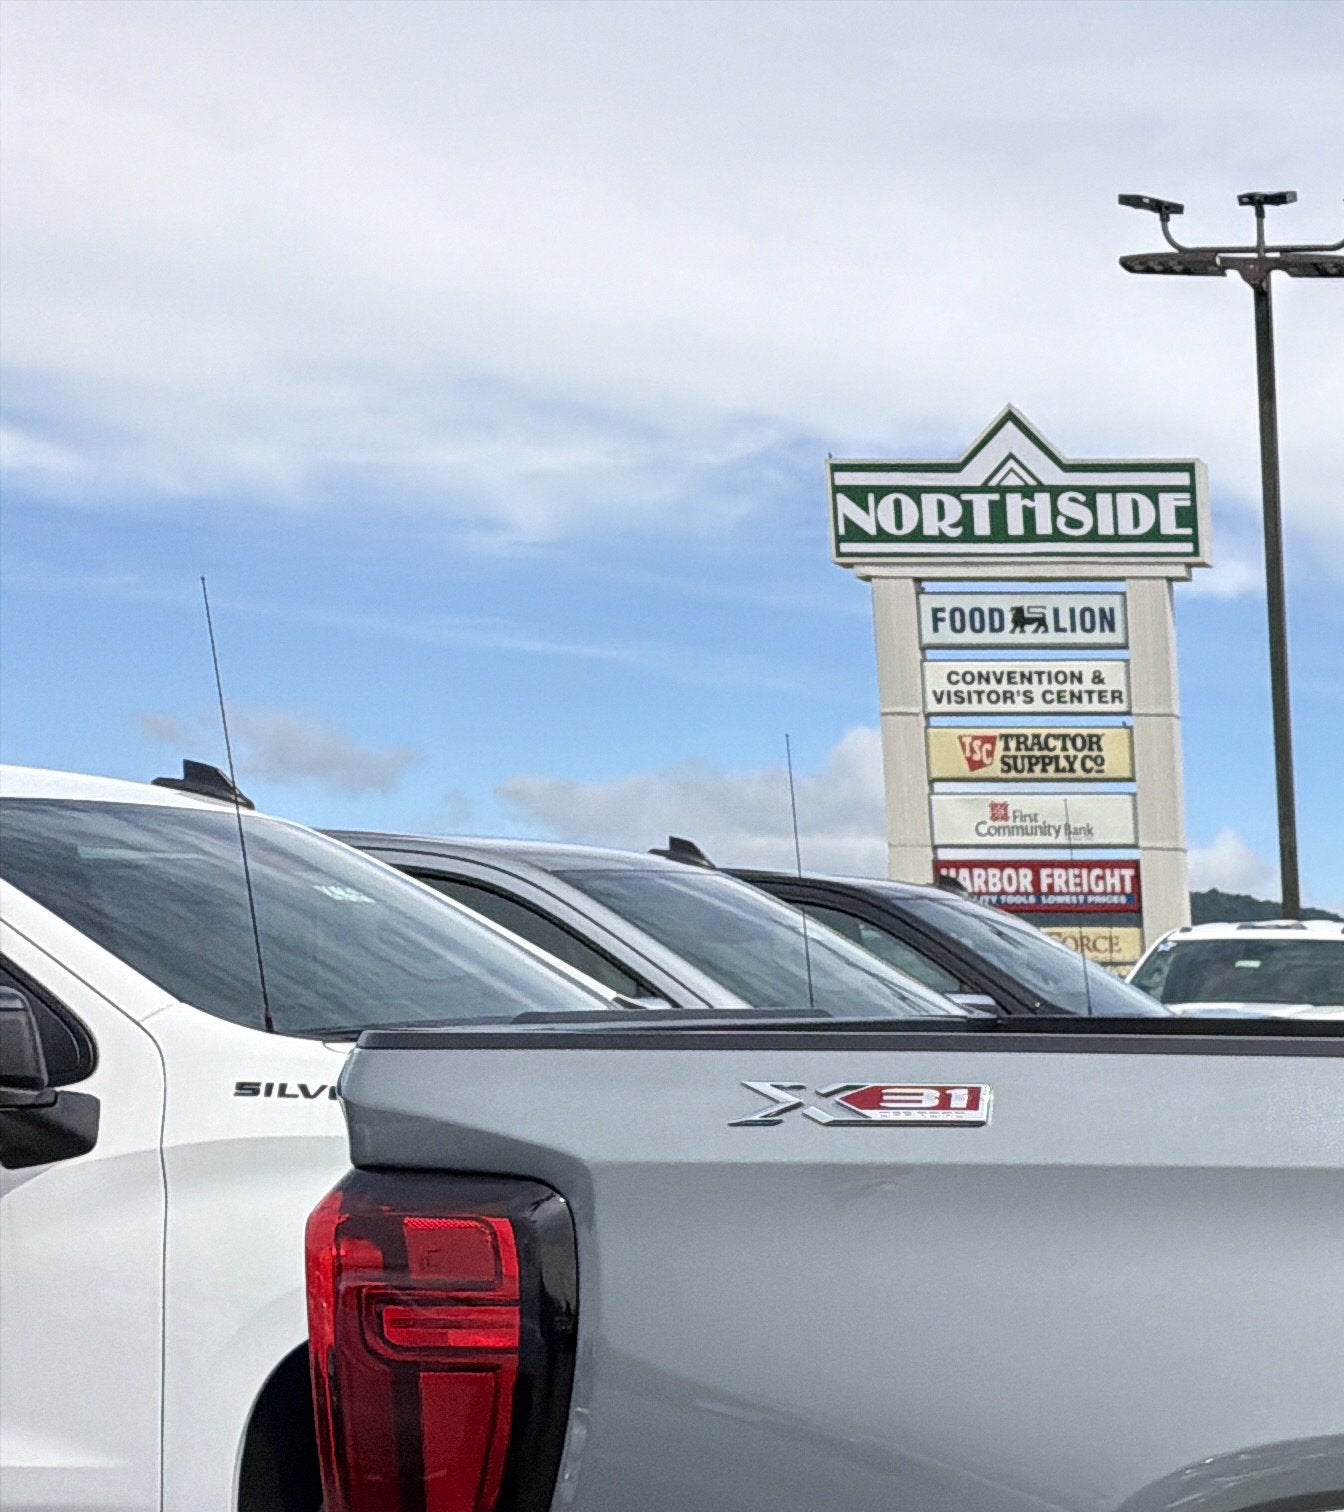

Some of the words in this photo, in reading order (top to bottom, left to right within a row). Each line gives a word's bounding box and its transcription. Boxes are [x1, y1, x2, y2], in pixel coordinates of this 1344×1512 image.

[836, 491, 1193, 538] NORTHSIDE
[931, 606, 1005, 634] FOOD
[1052, 606, 1116, 634] LION
[946, 670, 1083, 686] CONVENTION
[1091, 669, 1106, 686] &
[932, 689, 1035, 705] VISITOR'S
[1041, 689, 1125, 705] CENTER
[961, 736, 994, 766] TSC
[999, 733, 1104, 752] TRACTOR
[1000, 754, 1078, 774] SUPPLY
[1012, 809, 1040, 824] First
[975, 820, 1062, 839] Community
[940, 867, 1034, 893] ARBOR
[1039, 867, 1136, 894] FREIGHT
